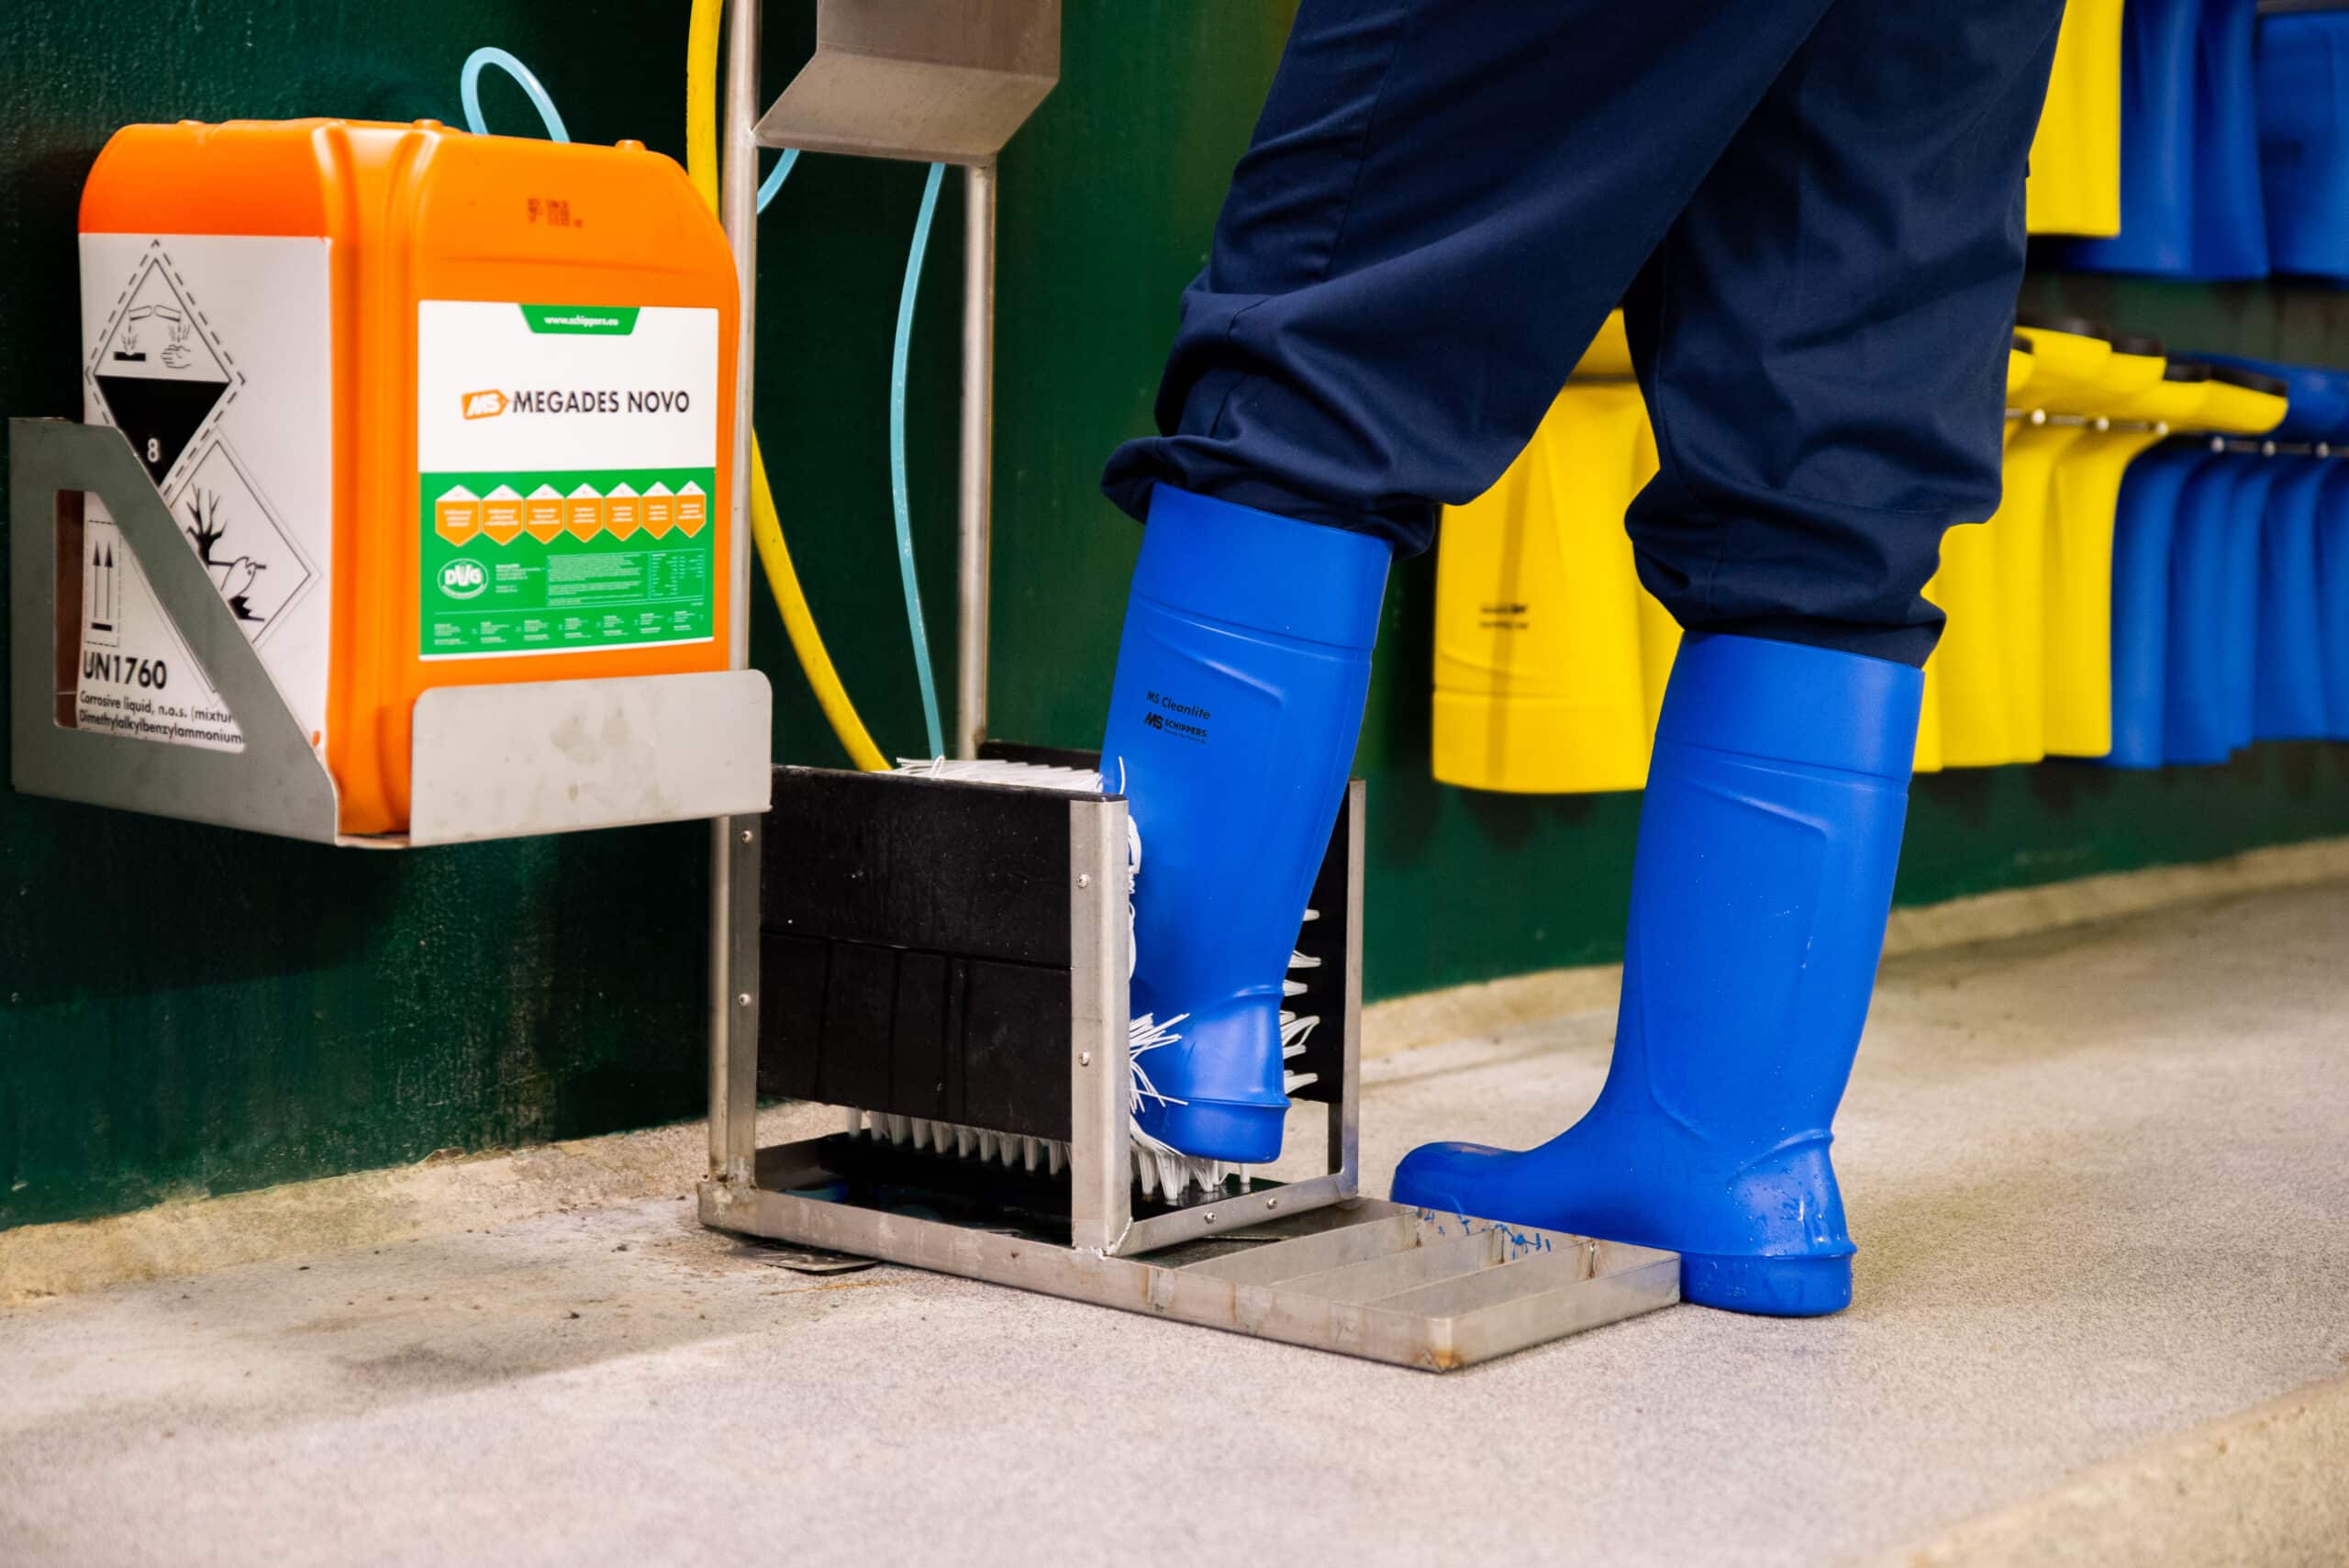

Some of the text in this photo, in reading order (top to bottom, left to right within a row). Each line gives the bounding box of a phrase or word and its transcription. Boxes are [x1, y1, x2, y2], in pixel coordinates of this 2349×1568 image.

[466, 390, 690, 417] MS MEGADES NOVO
[147, 438, 160, 463] 8
[444, 563, 484, 587] DVG
[83, 651, 168, 690] UN1760
[80, 690, 232, 724] Corrosive liquid, n.o.s. (mixtur
[1146, 690, 1161, 705] MS
[79, 709, 244, 745] Dimethylalkylbenzylammonium
[1144, 711, 1163, 731] MS
[1164, 718, 1208, 738] SCHIPPERS
